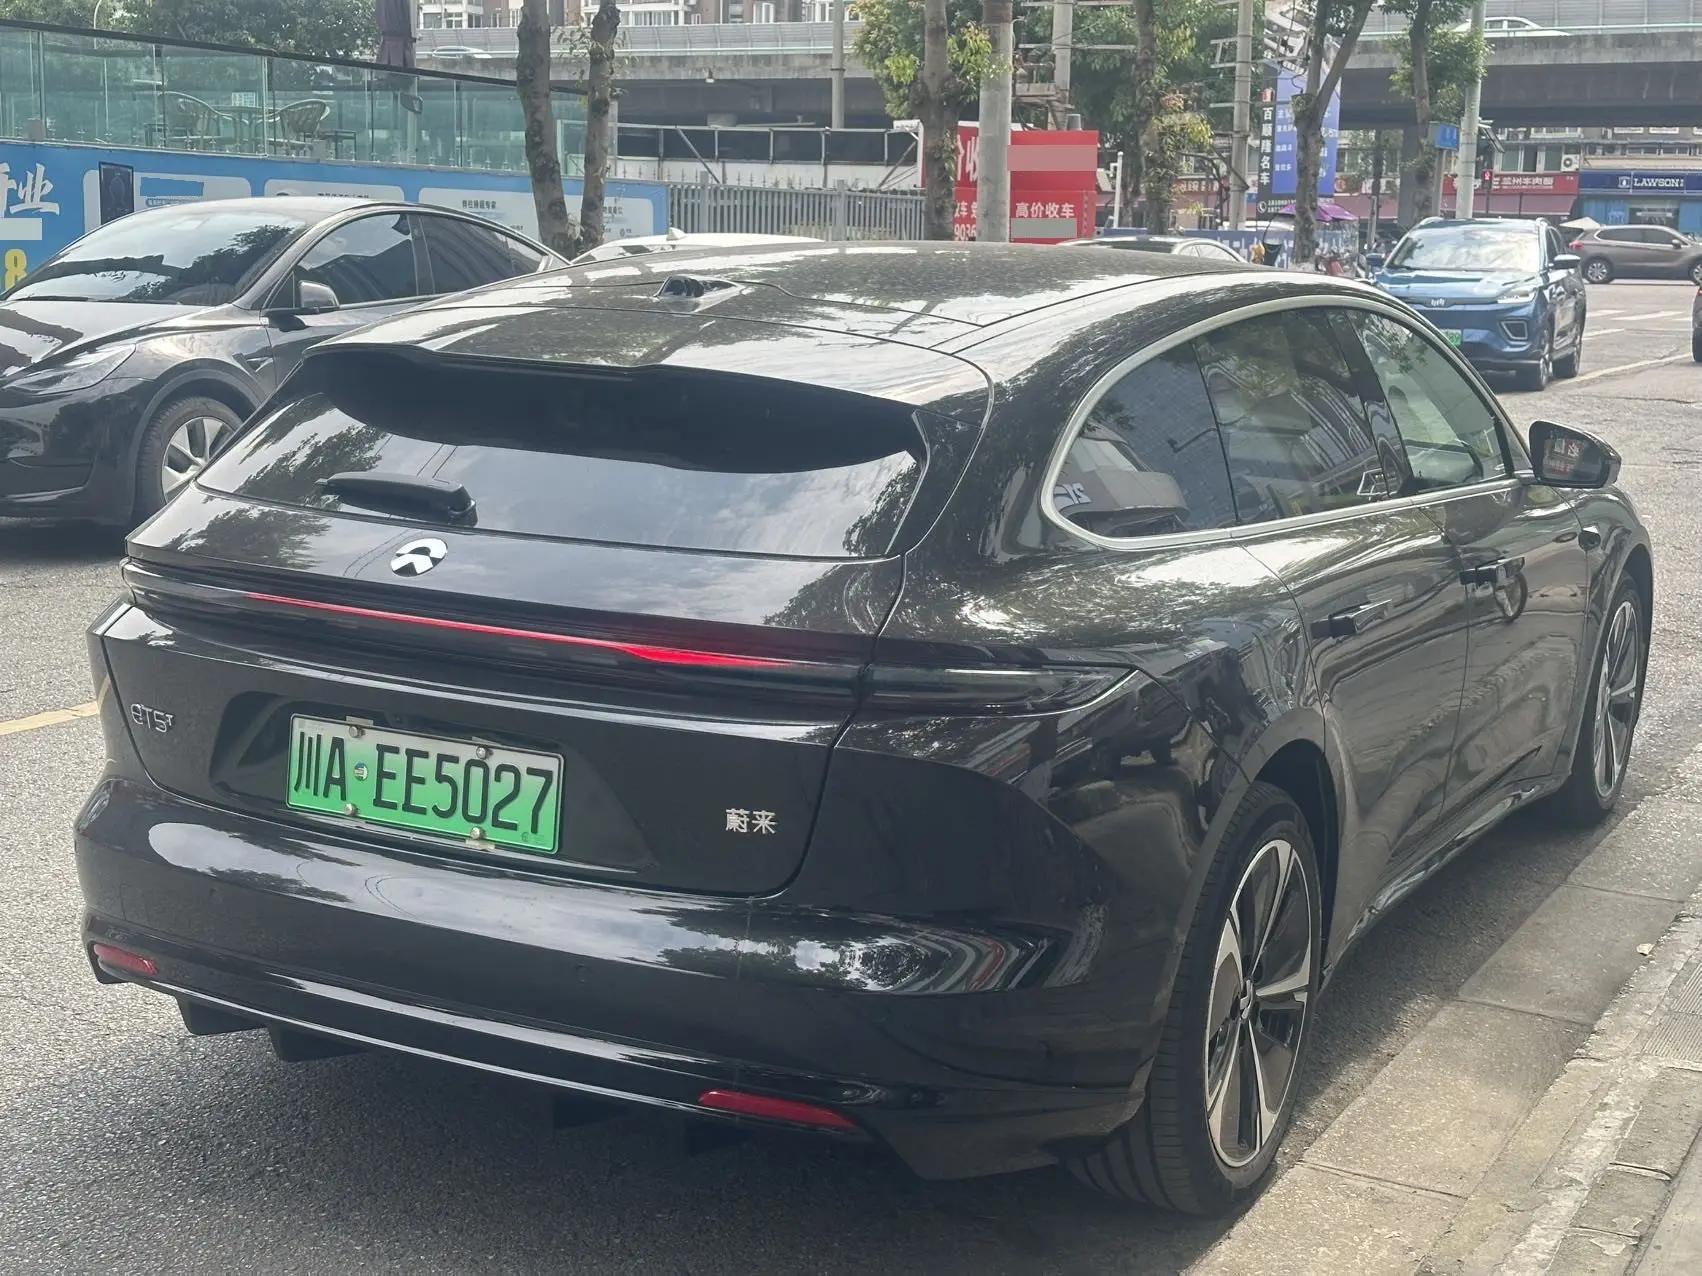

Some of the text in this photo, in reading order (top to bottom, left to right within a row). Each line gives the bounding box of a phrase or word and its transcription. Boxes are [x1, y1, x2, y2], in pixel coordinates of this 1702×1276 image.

[1633, 178, 1679, 188] LAWSON
[1015, 202, 1075, 219] 高价收车
[372, 743, 554, 835] EE5027
[725, 808, 777, 834] 蔚来
